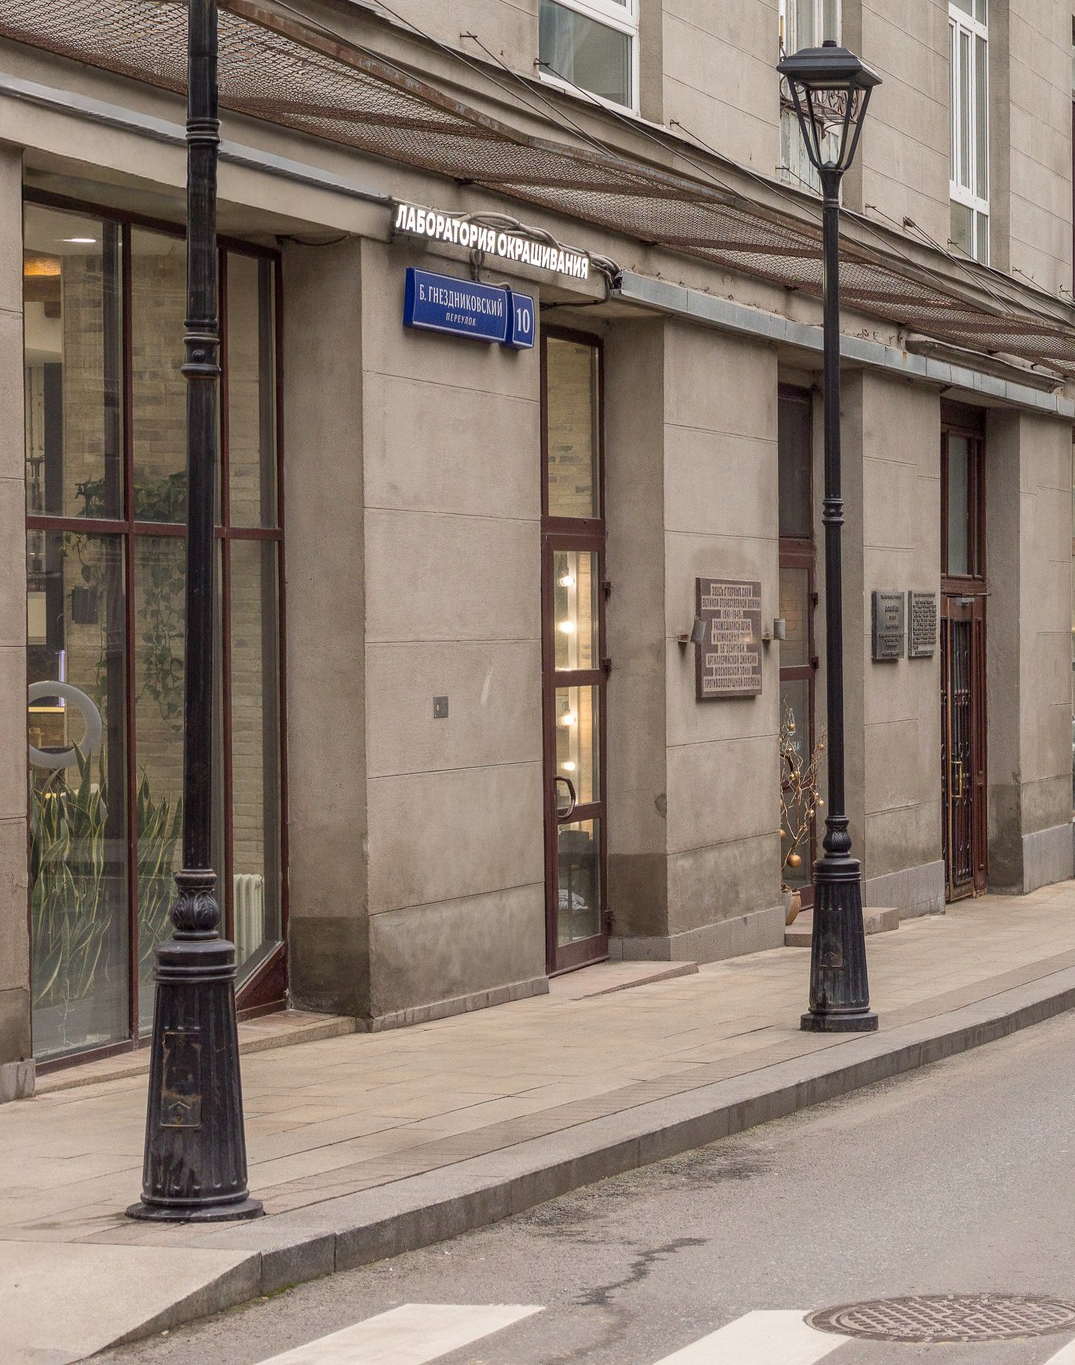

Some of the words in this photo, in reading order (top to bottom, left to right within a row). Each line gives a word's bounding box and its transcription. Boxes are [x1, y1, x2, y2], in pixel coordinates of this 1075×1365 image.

[395, 205, 496, 254] ЛАБОРАТОРИЯ
[497, 234, 589, 280] ОКРАШИВАНИЯ
[419, 284, 427, 302] Б.
[428, 286, 503, 317] ГНЕЗДНИКОВСКИЙ
[516, 307, 531, 334] 10
[445, 312, 477, 327] ПЕРЕУЛОК
